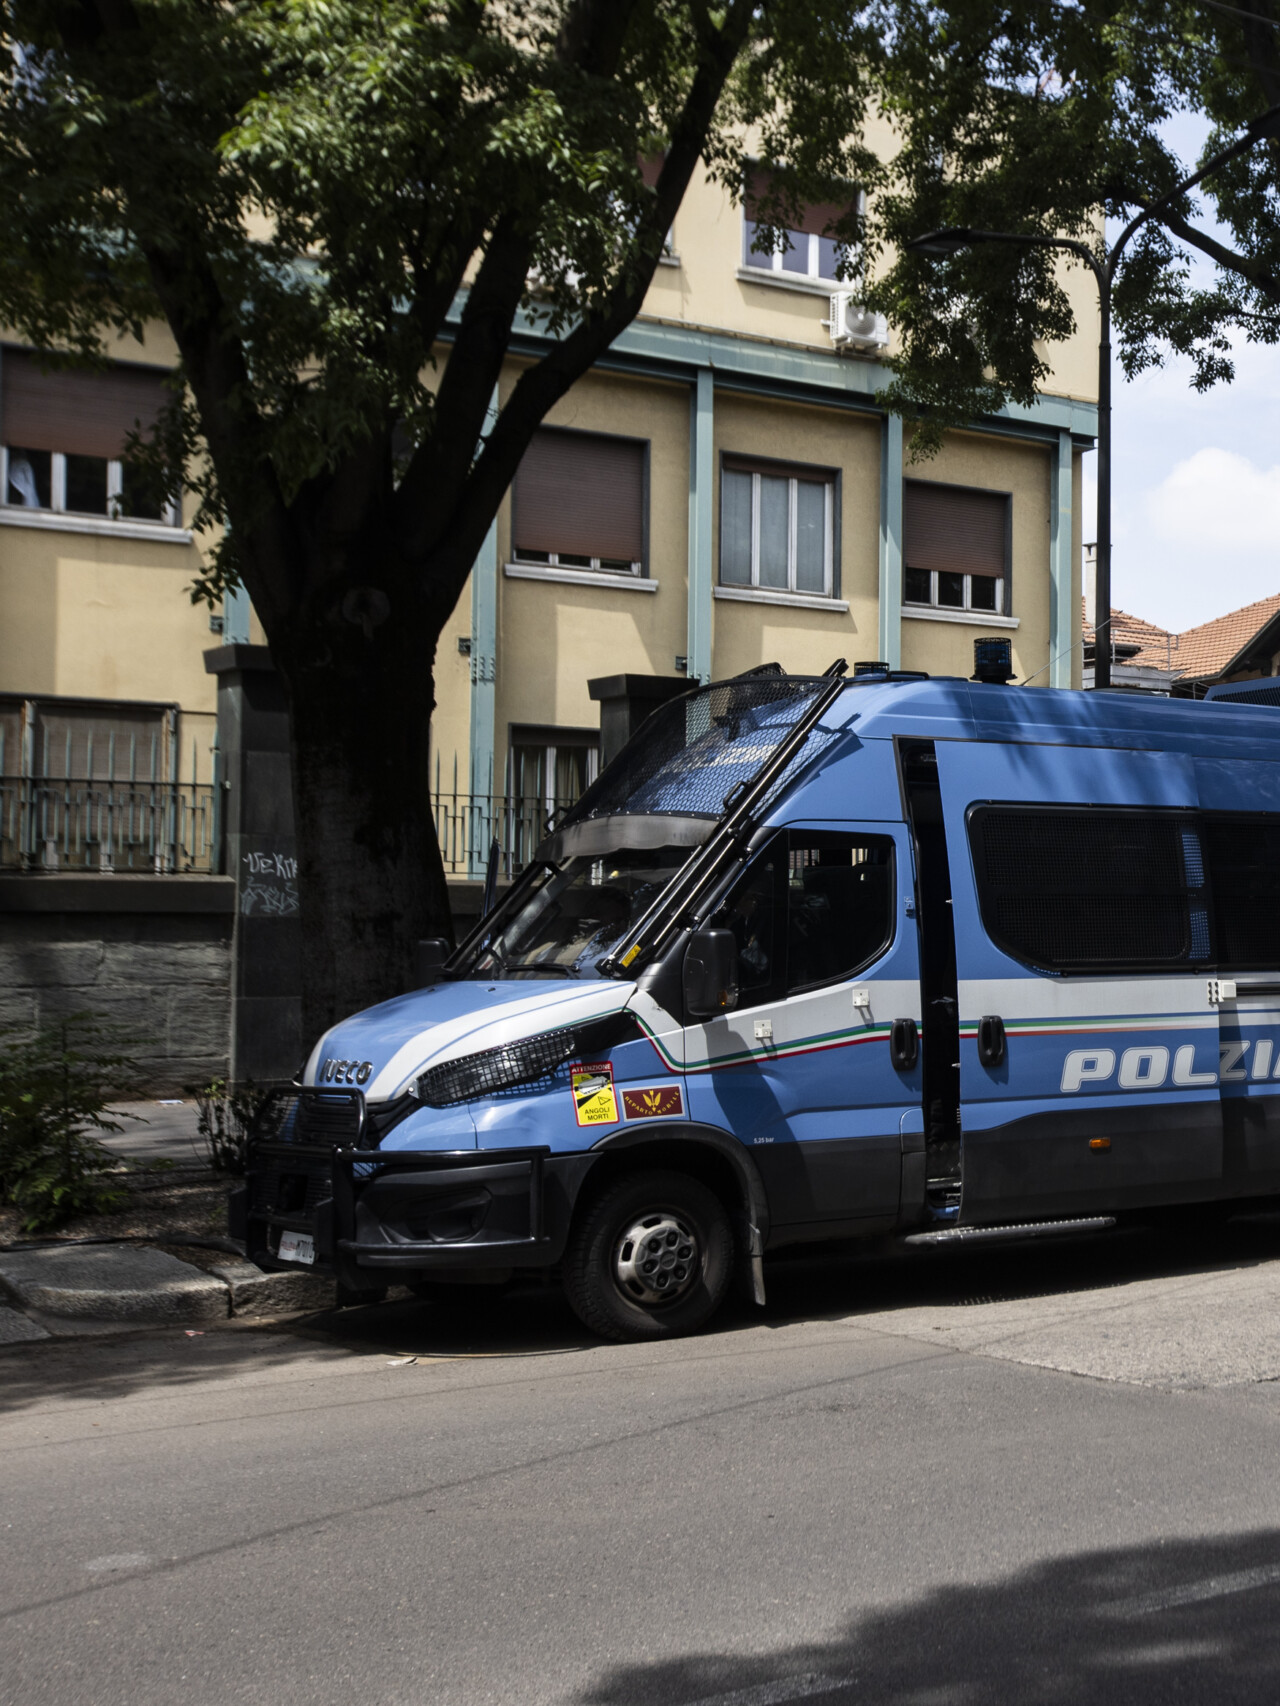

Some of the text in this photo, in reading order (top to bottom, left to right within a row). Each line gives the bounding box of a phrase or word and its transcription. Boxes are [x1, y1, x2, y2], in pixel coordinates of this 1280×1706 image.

[319, 1058, 374, 1086] IVECO
[571, 1063, 612, 1074] ATTENZIONE
[624, 1091, 680, 1116] REPARTO MOBILE
[584, 1106, 610, 1115] ANGOLI
[587, 1113, 609, 1121] MORTI
